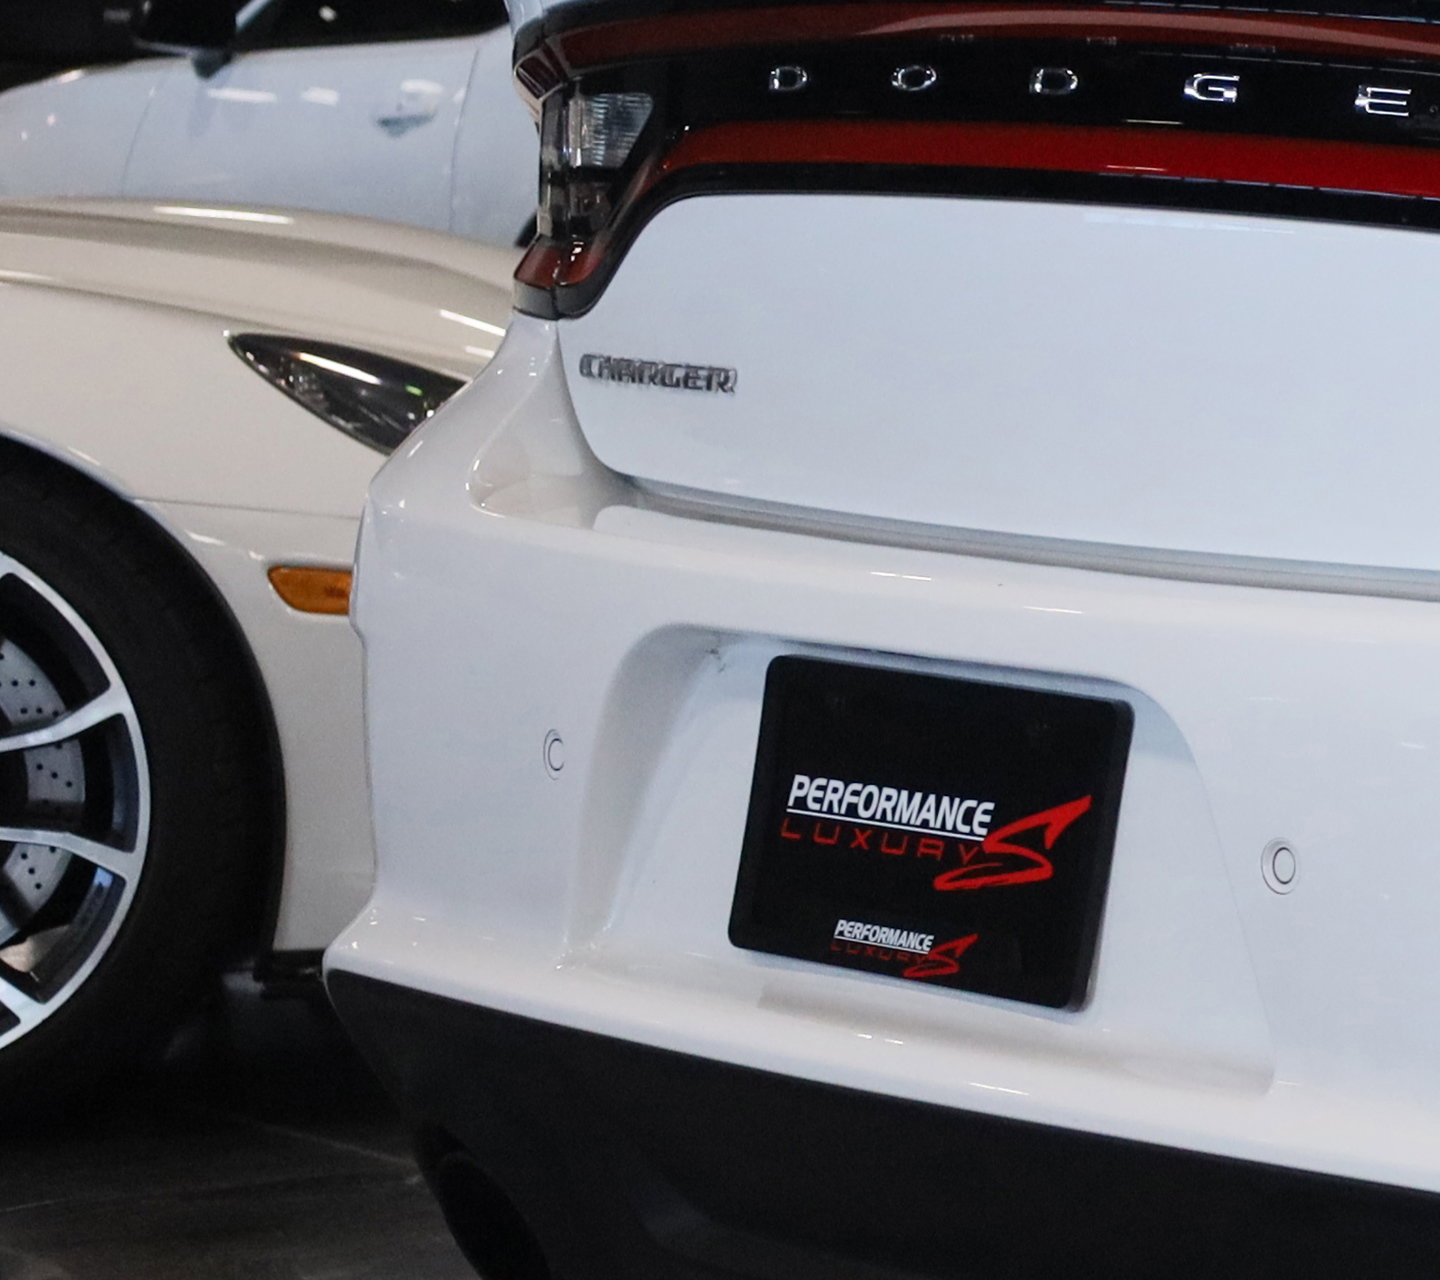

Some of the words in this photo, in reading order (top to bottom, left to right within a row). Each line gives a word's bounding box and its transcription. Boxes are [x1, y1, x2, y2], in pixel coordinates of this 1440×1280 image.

[768, 64, 1412, 117] DODGE
[579, 353, 738, 394] CHARGER
[786, 773, 995, 836] PERFORMANCE
[780, 818, 981, 865] LUXURY
[834, 919, 935, 951] PERFORMANCE
